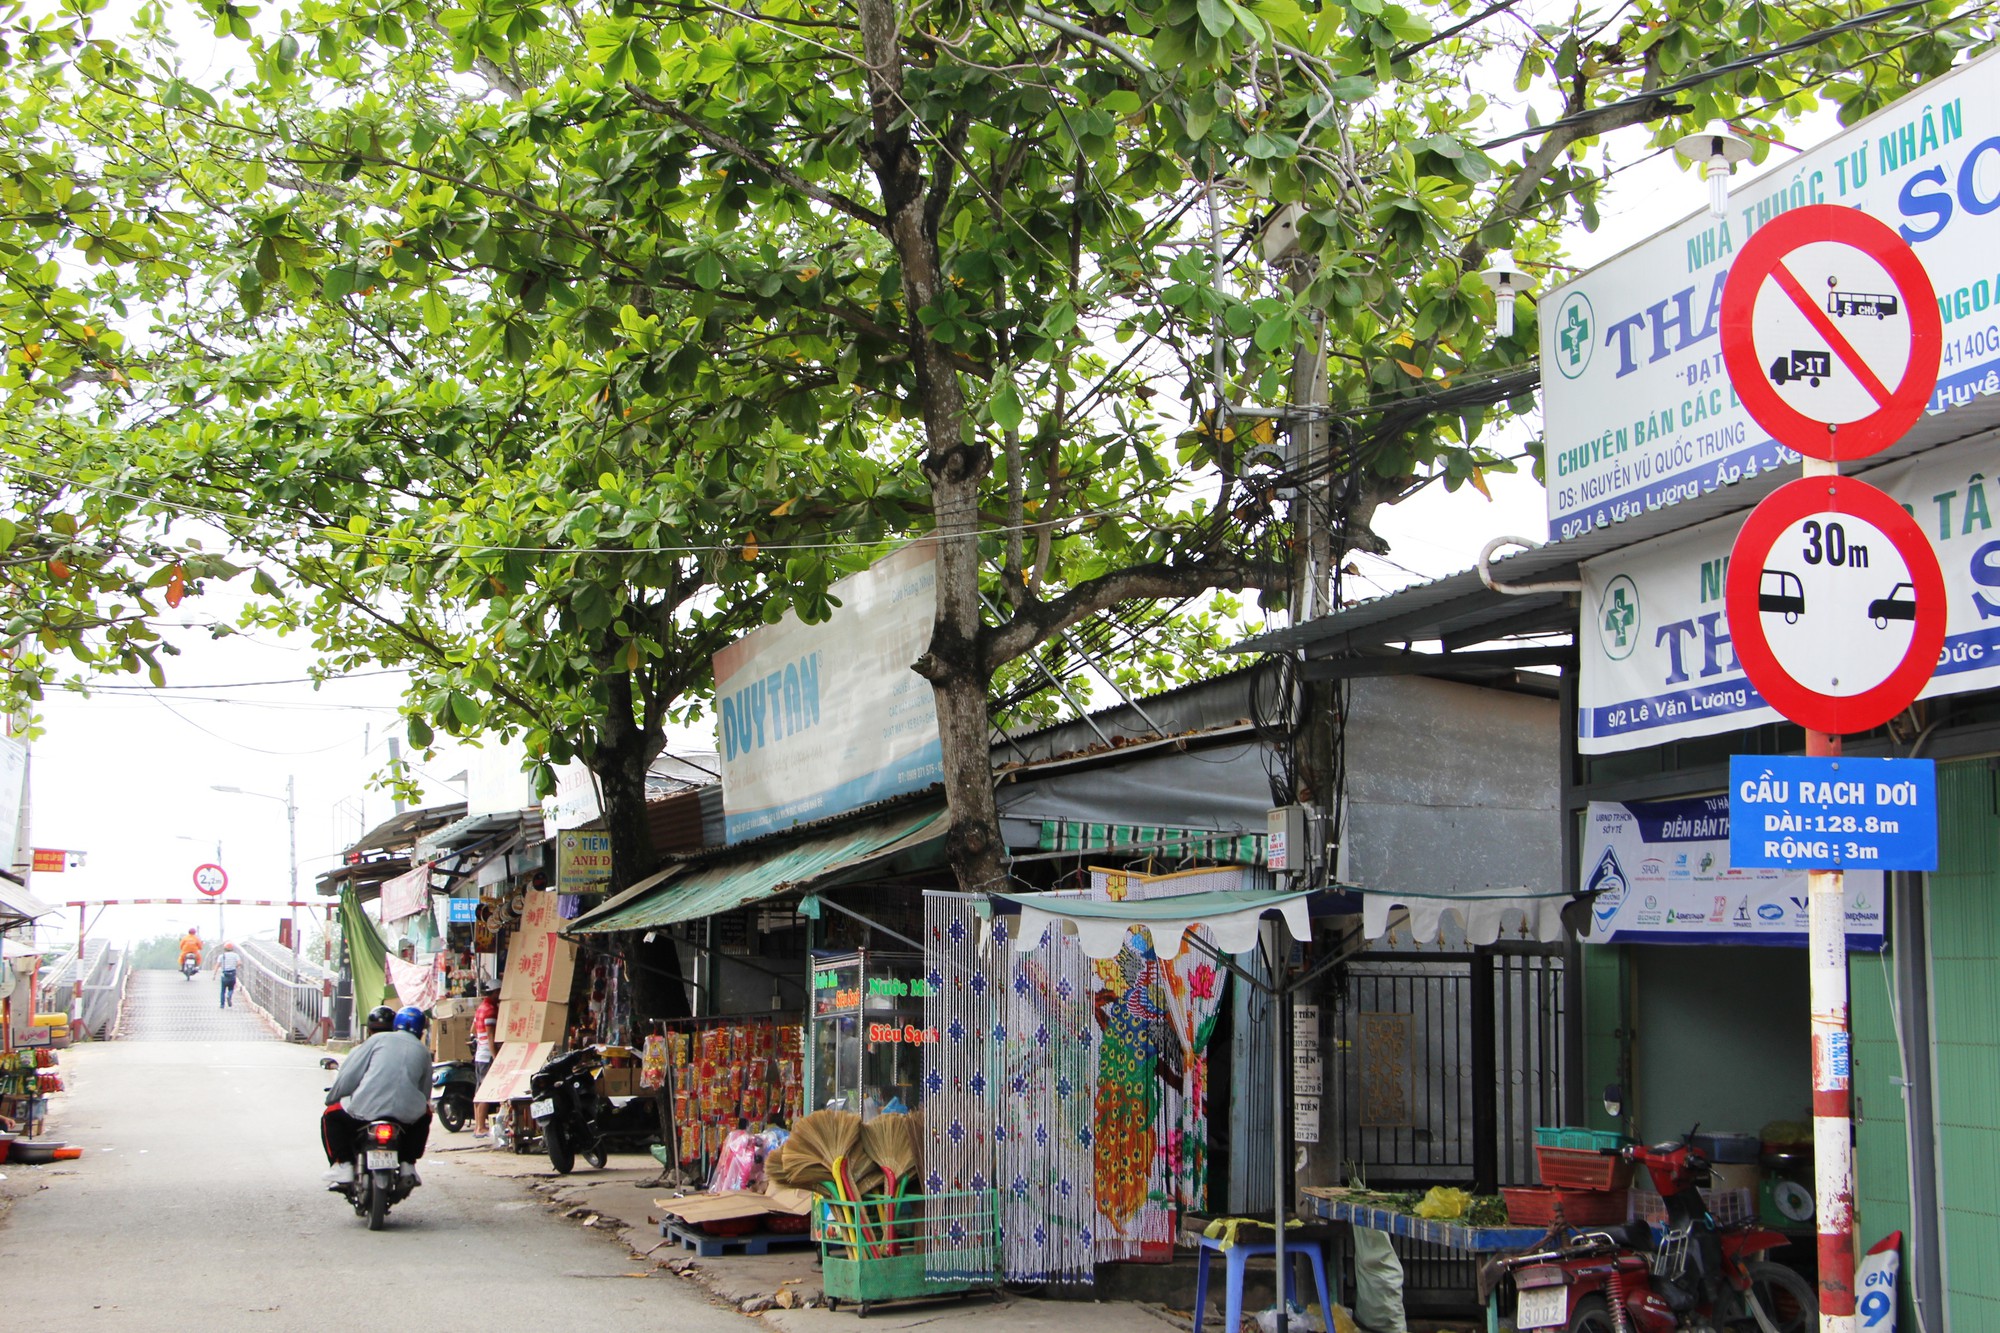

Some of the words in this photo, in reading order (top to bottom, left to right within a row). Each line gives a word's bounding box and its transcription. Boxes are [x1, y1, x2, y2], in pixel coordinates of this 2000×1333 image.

[1743, 167, 1824, 240] THUỐC
[1834, 140, 1869, 197] TƯ
[1878, 97, 1963, 176] NHÂN
[1844, 302, 1853, 315] 5
[1557, 427, 1628, 477] CHUYÊN
[1634, 410, 1675, 447] BÁN
[1680, 388, 1722, 428] CÁC
[1580, 457, 1631, 503] NGUYỄN
[1634, 455, 1652, 482] VŨ
[1655, 435, 1693, 475] QUỐC
[1697, 421, 1746, 456] TRUNG
[1610, 499, 1641, 522] Văn
[1802, 520, 1870, 568] 30m
[1608, 708, 1627, 728] 9/2
[1630, 705, 1650, 724] Lê
[1655, 699, 1687, 719] Văn
[1692, 688, 1747, 712] Lương
[1740, 768, 1789, 804] CẦU
[1799, 781, 1865, 810] RẠCH
[1876, 780, 1917, 806] DƠI
[1661, 814, 1692, 839] ĐIỂM
[1693, 815, 1716, 837] BÁN
[582, 834, 609, 853] TIỆM
[1844, 842, 1879, 860] 3m
[572, 855, 598, 866] ANH
[868, 977, 908, 997] Nước
[870, 1022, 902, 1043] Siêu
[904, 1024, 940, 1048] Sạch
[1524, 1305, 1560, 1325] 9002
